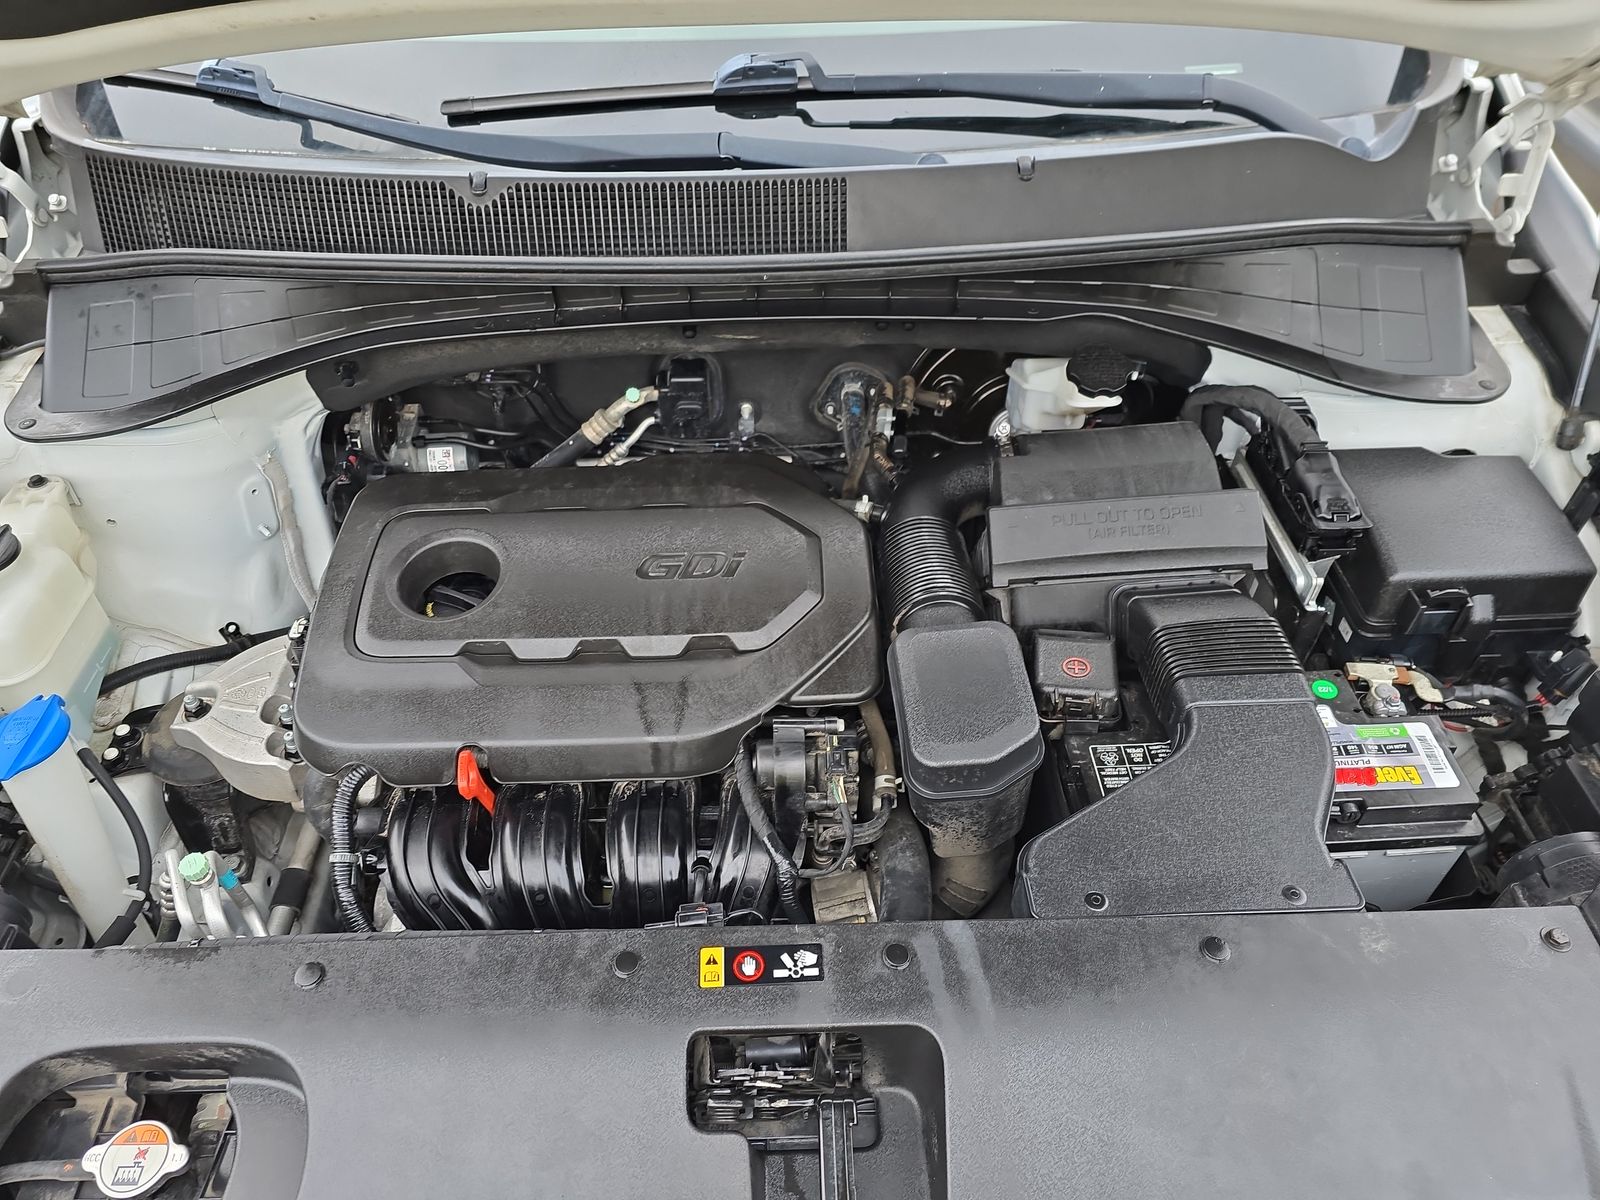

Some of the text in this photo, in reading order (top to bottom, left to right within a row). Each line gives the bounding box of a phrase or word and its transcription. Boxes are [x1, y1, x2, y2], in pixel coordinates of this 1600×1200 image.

[1052, 505, 1203, 527] PULL OUT TO OPEN
[1088, 523, 1171, 541] (AIR FILTER)
[635, 550, 749, 580] GDi
